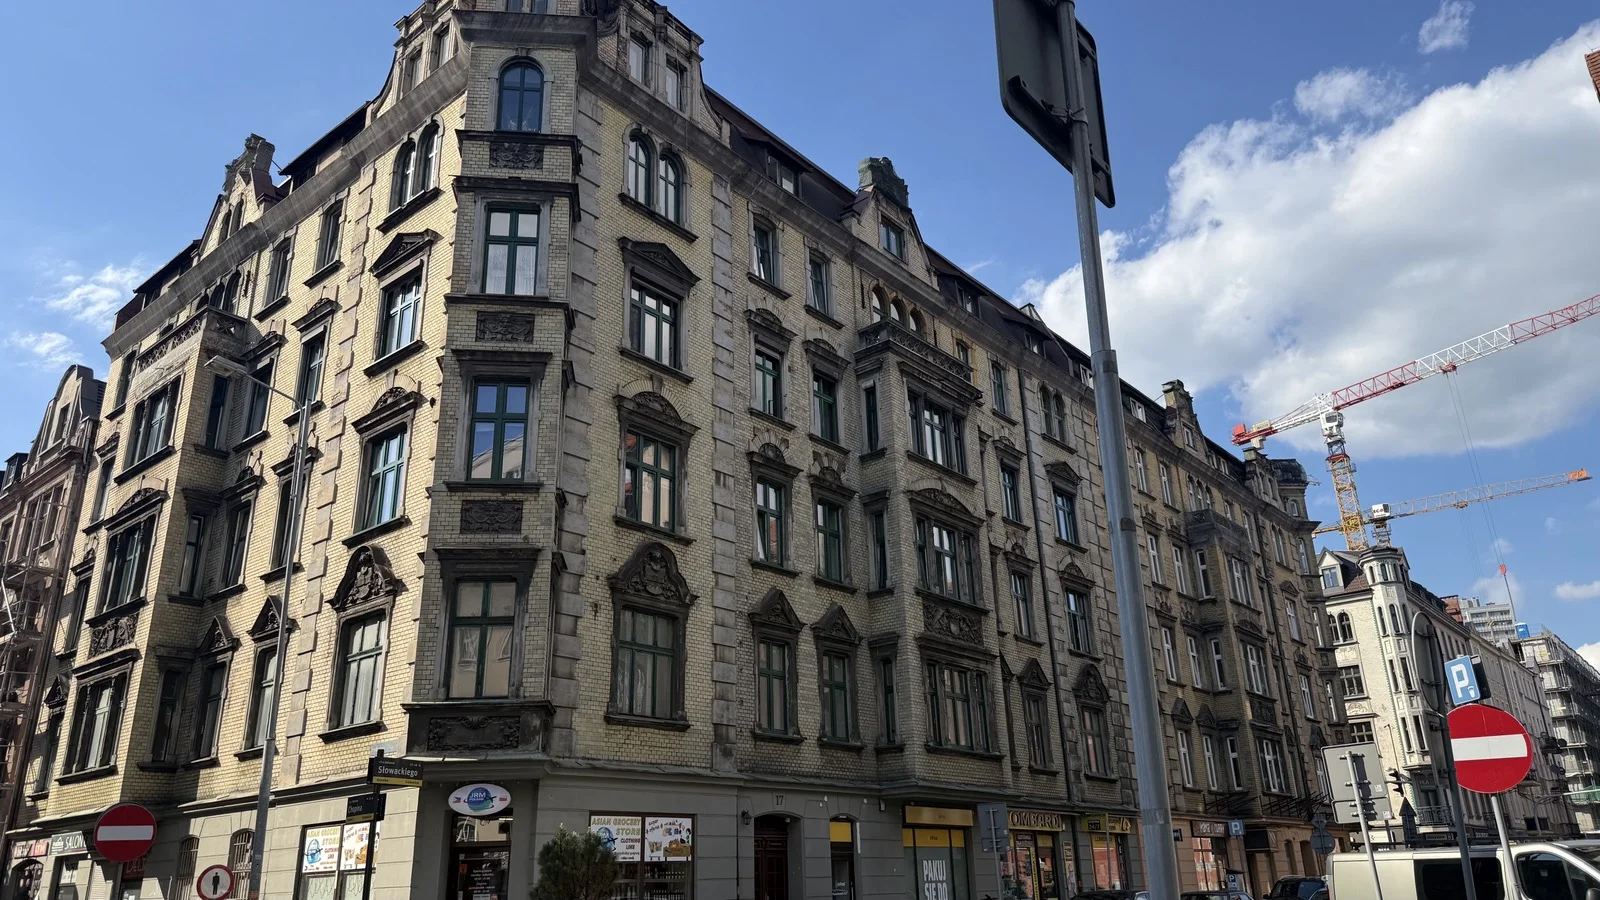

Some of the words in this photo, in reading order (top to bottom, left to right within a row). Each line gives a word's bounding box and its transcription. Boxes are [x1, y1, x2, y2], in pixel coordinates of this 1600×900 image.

[1451, 664, 1469, 698] P
[378, 765, 418, 777] Słowackiego
[776, 795, 784, 805] 17
[592, 817, 611, 826] ASIAN
[613, 818, 640, 826] GROCERY
[616, 828, 640, 836] STORE
[1231, 822, 1240, 834] P
[65, 835, 83, 850] SALON
[923, 860, 946, 881] PAKUJ
[937, 883, 948, 900] DO
